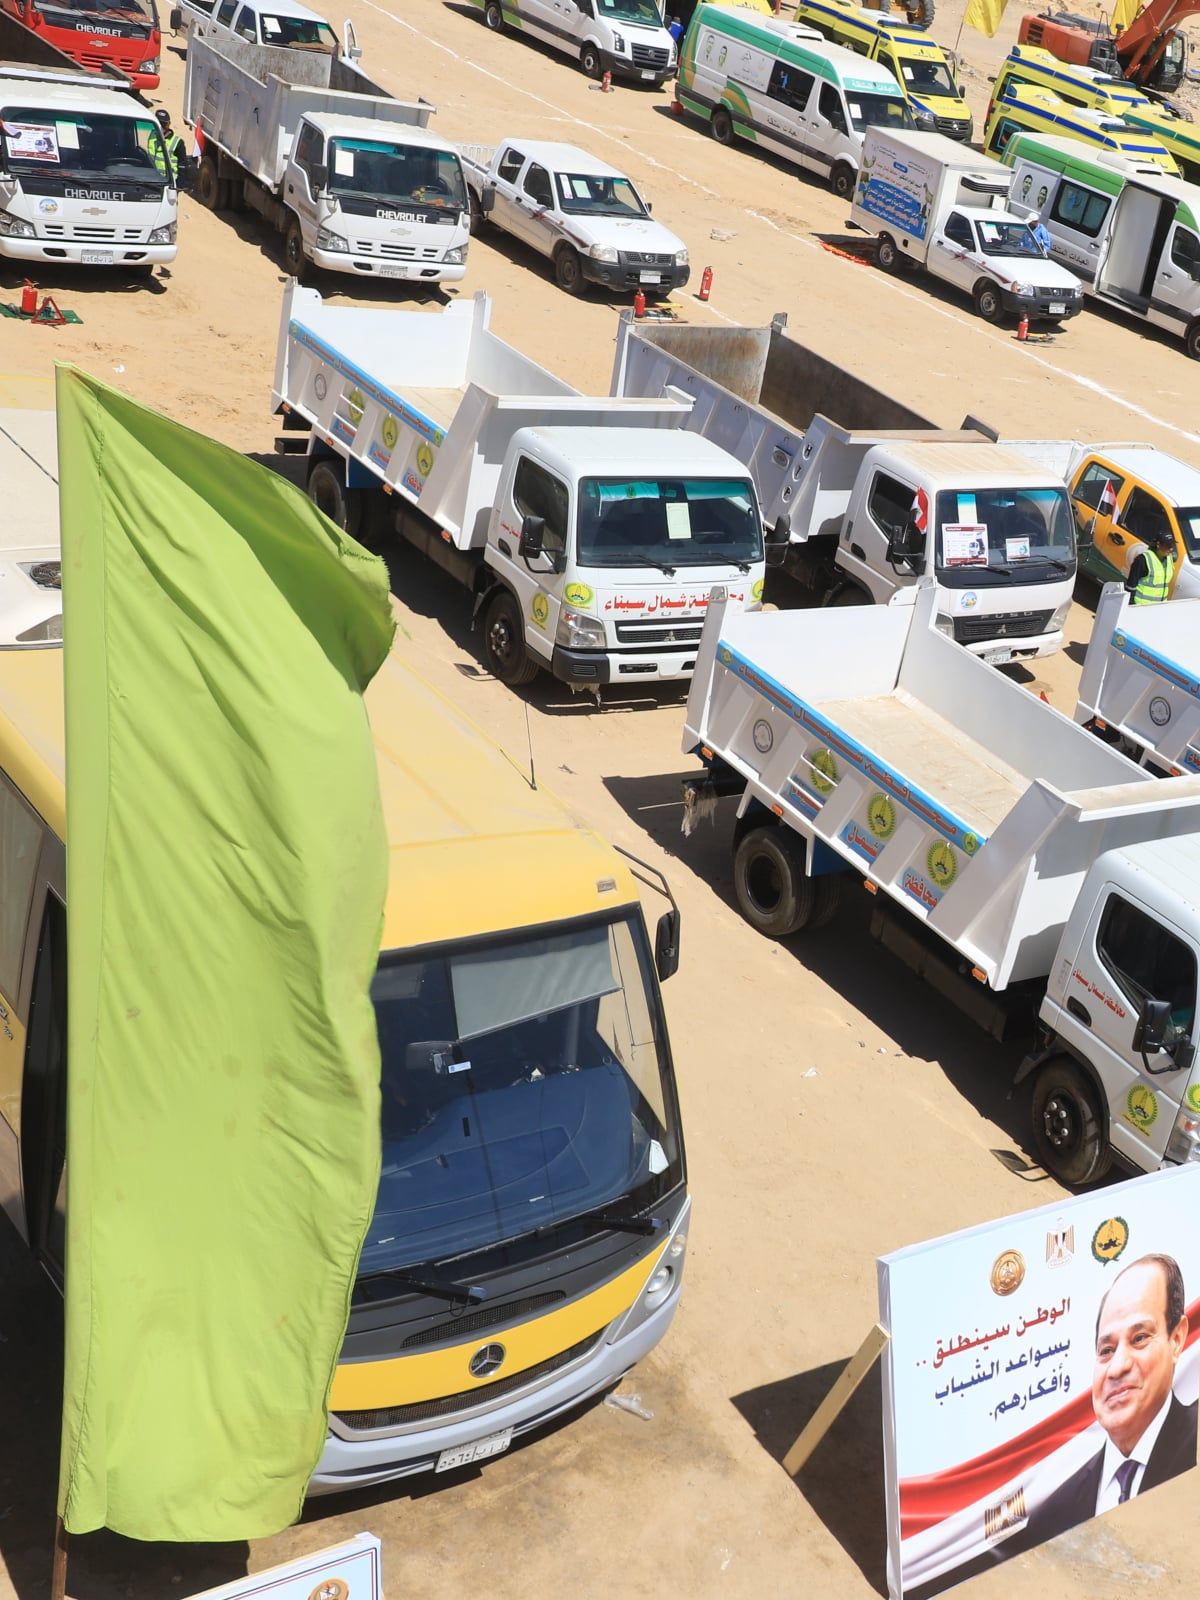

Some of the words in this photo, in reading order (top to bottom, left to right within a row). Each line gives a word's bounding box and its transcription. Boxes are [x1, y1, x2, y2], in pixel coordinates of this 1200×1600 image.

[76, 23, 122, 37] CHEVROLET
[64, 188, 125, 201] CHEVROLET
[376, 209, 428, 223] CHEVROLET
[604, 594, 645, 614] سيناء
[648, 592, 687, 613] شمال
[1015, 1296, 1071, 1337] الوطن
[932, 1321, 1011, 1370] سينطلق
[1005, 1338, 1071, 1377] بسواعد
[934, 1358, 1001, 1404] الشباب
[988, 1371, 1071, 1422] وأفكارهم.
